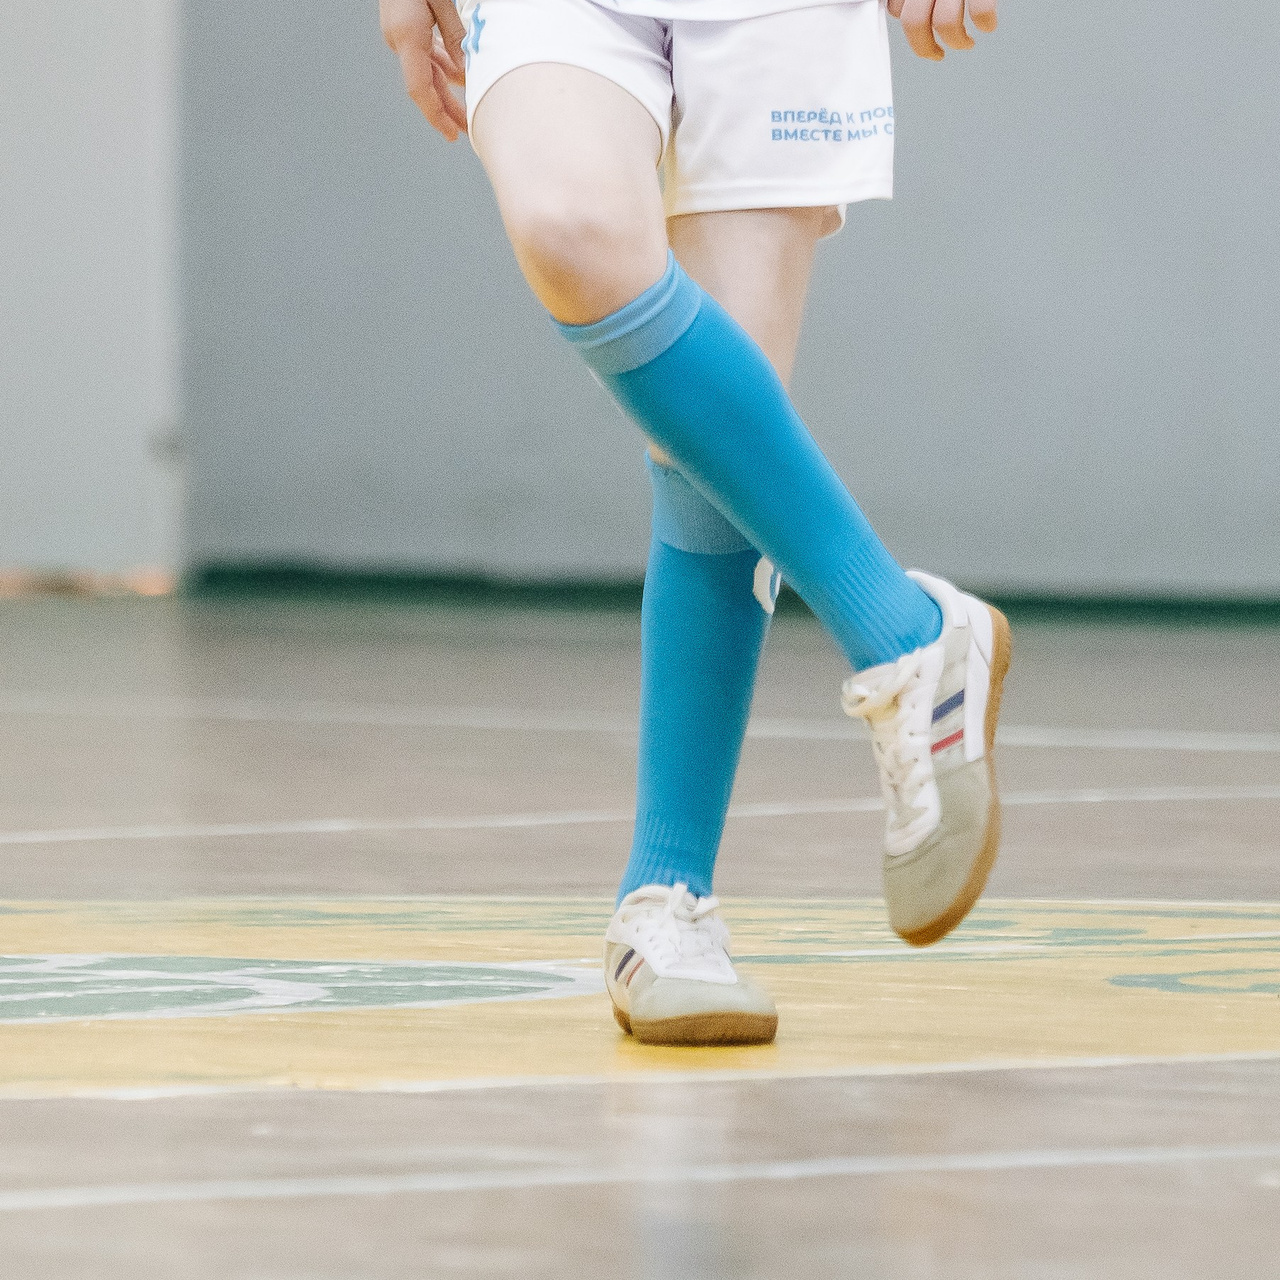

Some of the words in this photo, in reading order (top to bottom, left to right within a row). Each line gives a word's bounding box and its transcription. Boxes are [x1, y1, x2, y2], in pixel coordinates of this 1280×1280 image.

[771, 108, 842, 125] ВПЕРЁД
[846, 112, 854, 123] К
[771, 128, 842, 142] ВМЕСТЕ
[847, 125, 878, 141] МЫ
